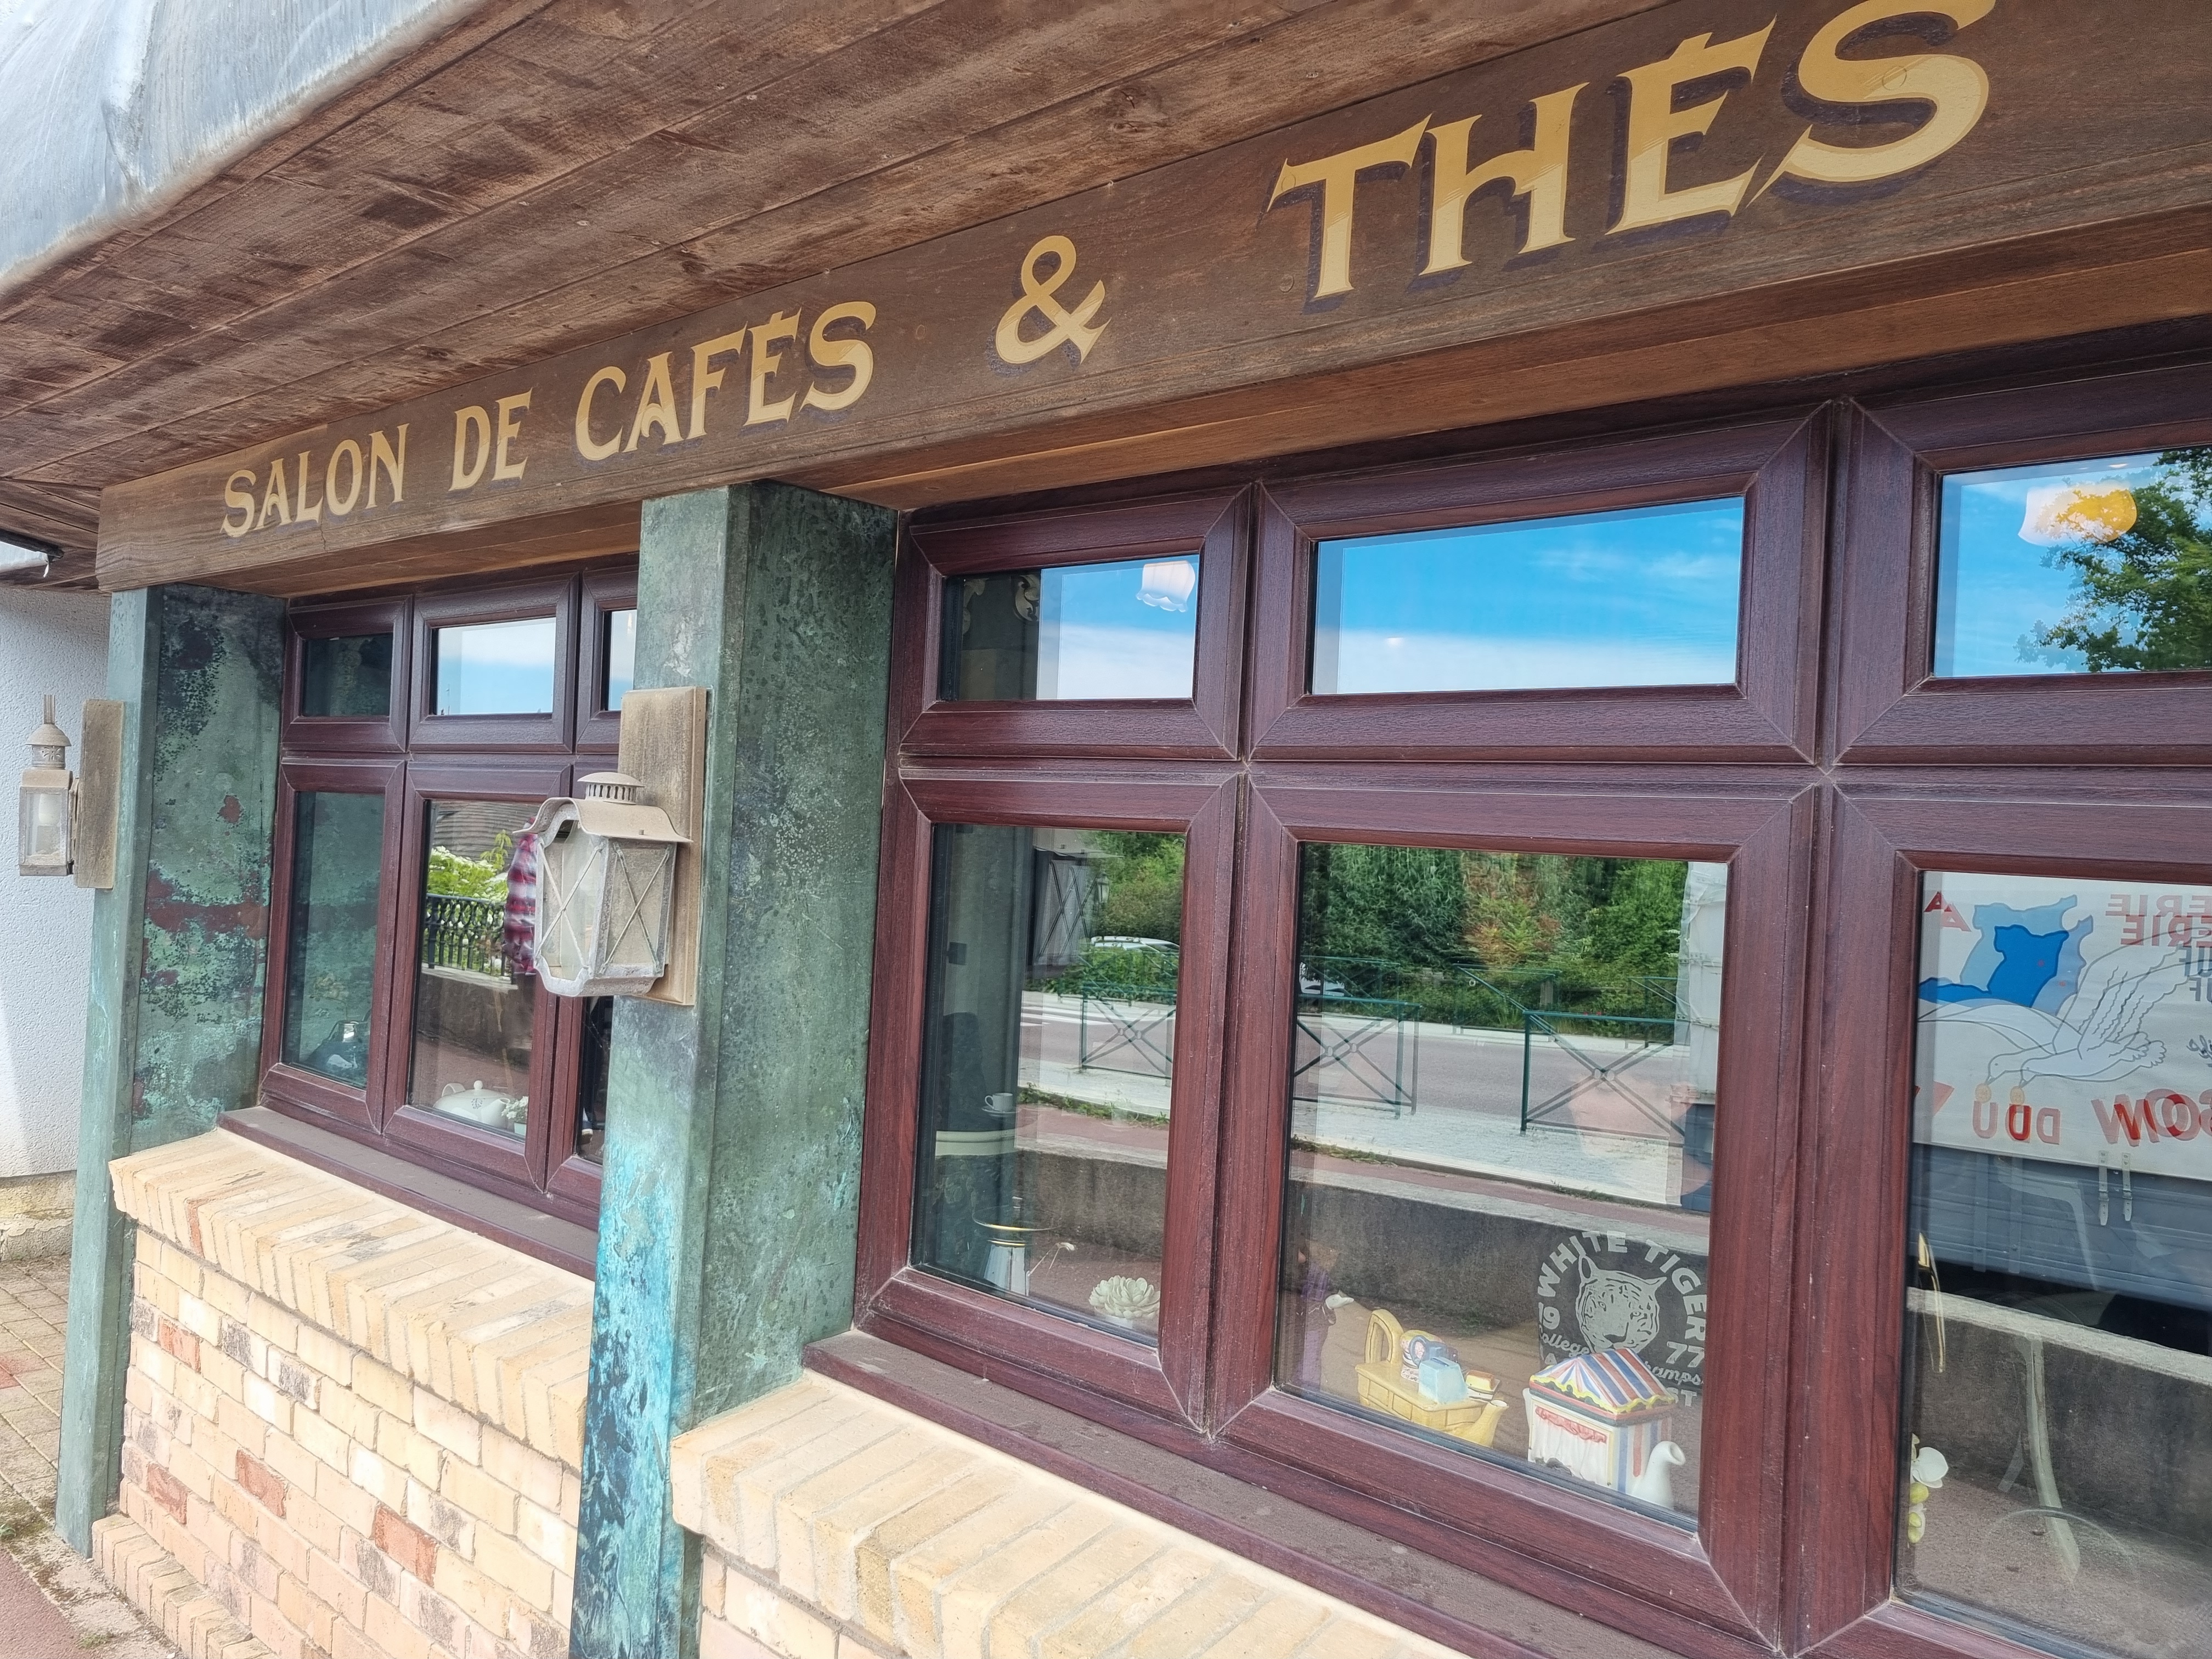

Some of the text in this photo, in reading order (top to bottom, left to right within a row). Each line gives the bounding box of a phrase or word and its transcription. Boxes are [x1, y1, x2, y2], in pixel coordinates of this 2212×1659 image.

[219, 422, 410, 538] SALON
[448, 387, 533, 492] DE
[995, 235, 1110, 364] &
[1537, 1231, 1707, 1341] WHITE TIGER
[1538, 1302, 1705, 1368] 19 77
